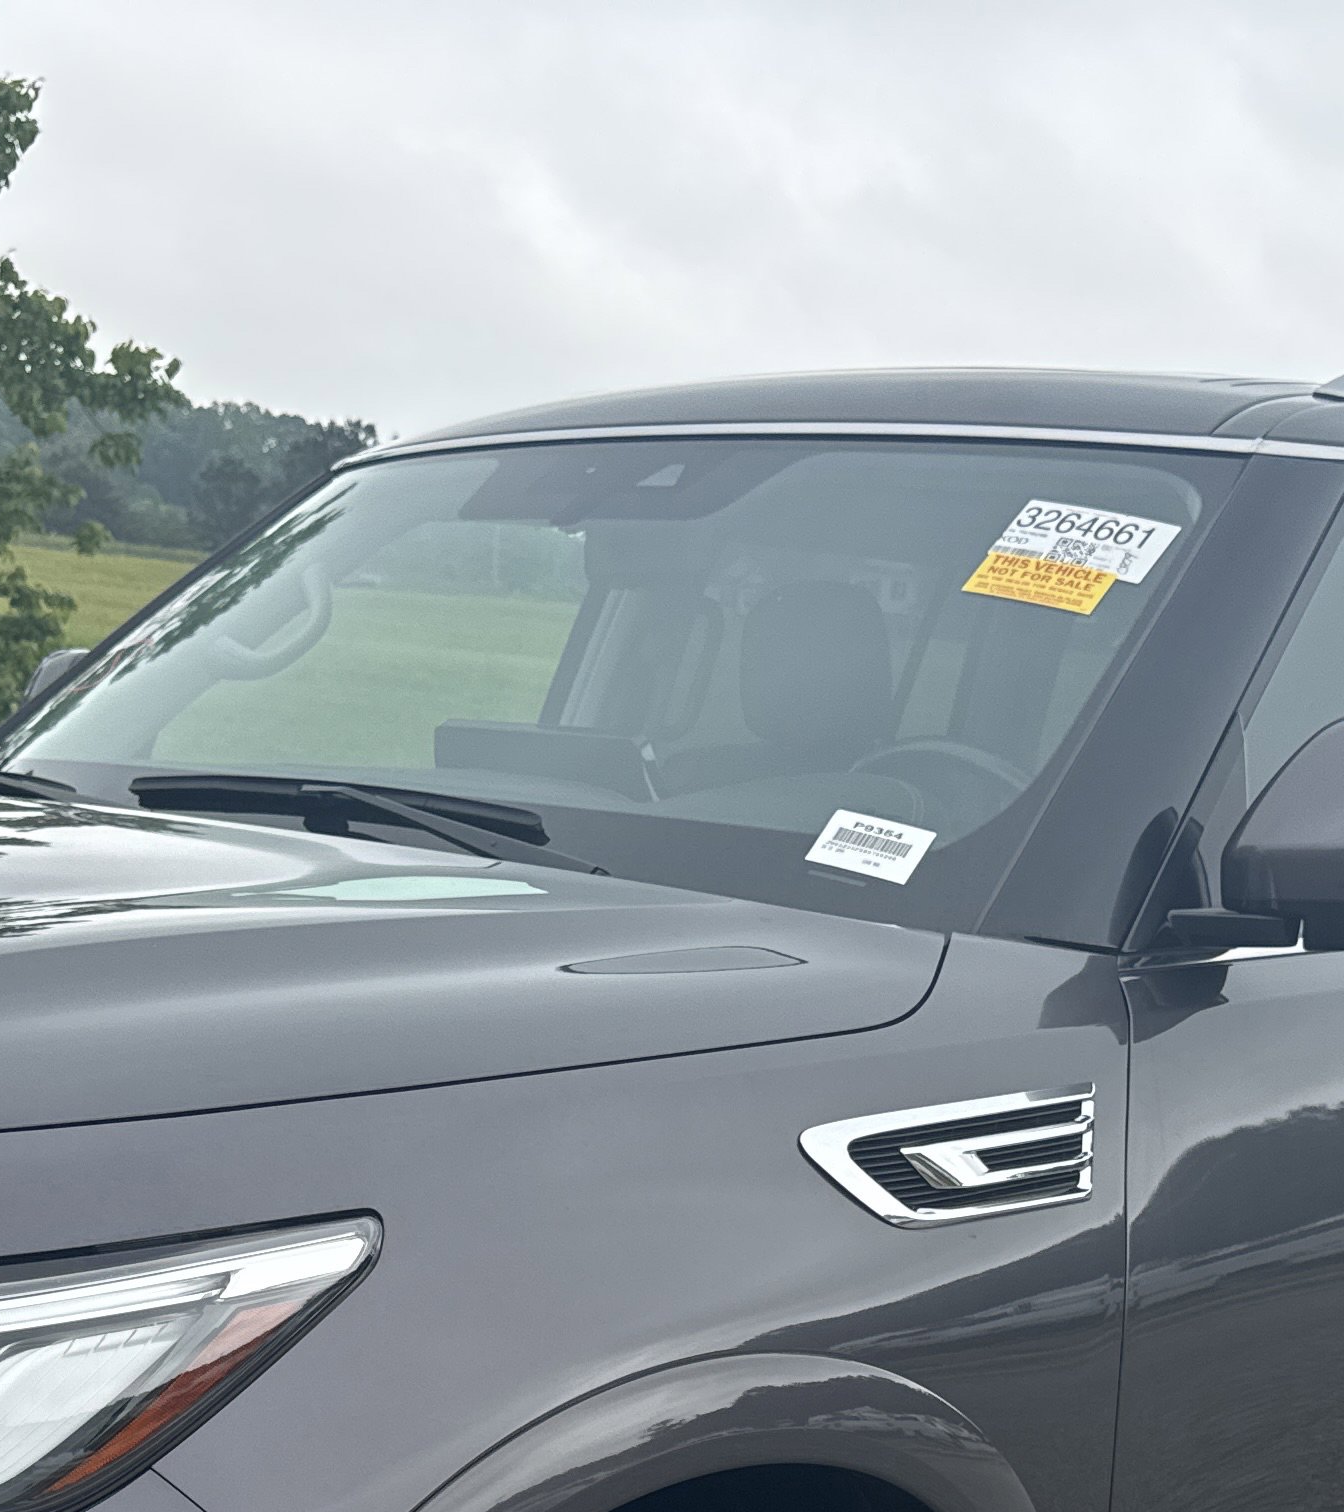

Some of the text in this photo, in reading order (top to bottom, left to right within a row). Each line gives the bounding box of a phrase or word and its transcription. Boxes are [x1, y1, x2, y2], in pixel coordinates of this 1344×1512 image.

[1016, 506, 1156, 549] 3264661
[987, 566, 1019, 577] NOT
[1020, 571, 1052, 583] FOR
[1056, 578, 1096, 592] SALE
[992, 554, 1031, 569] THIS
[1034, 560, 1108, 584] VEHICLE
